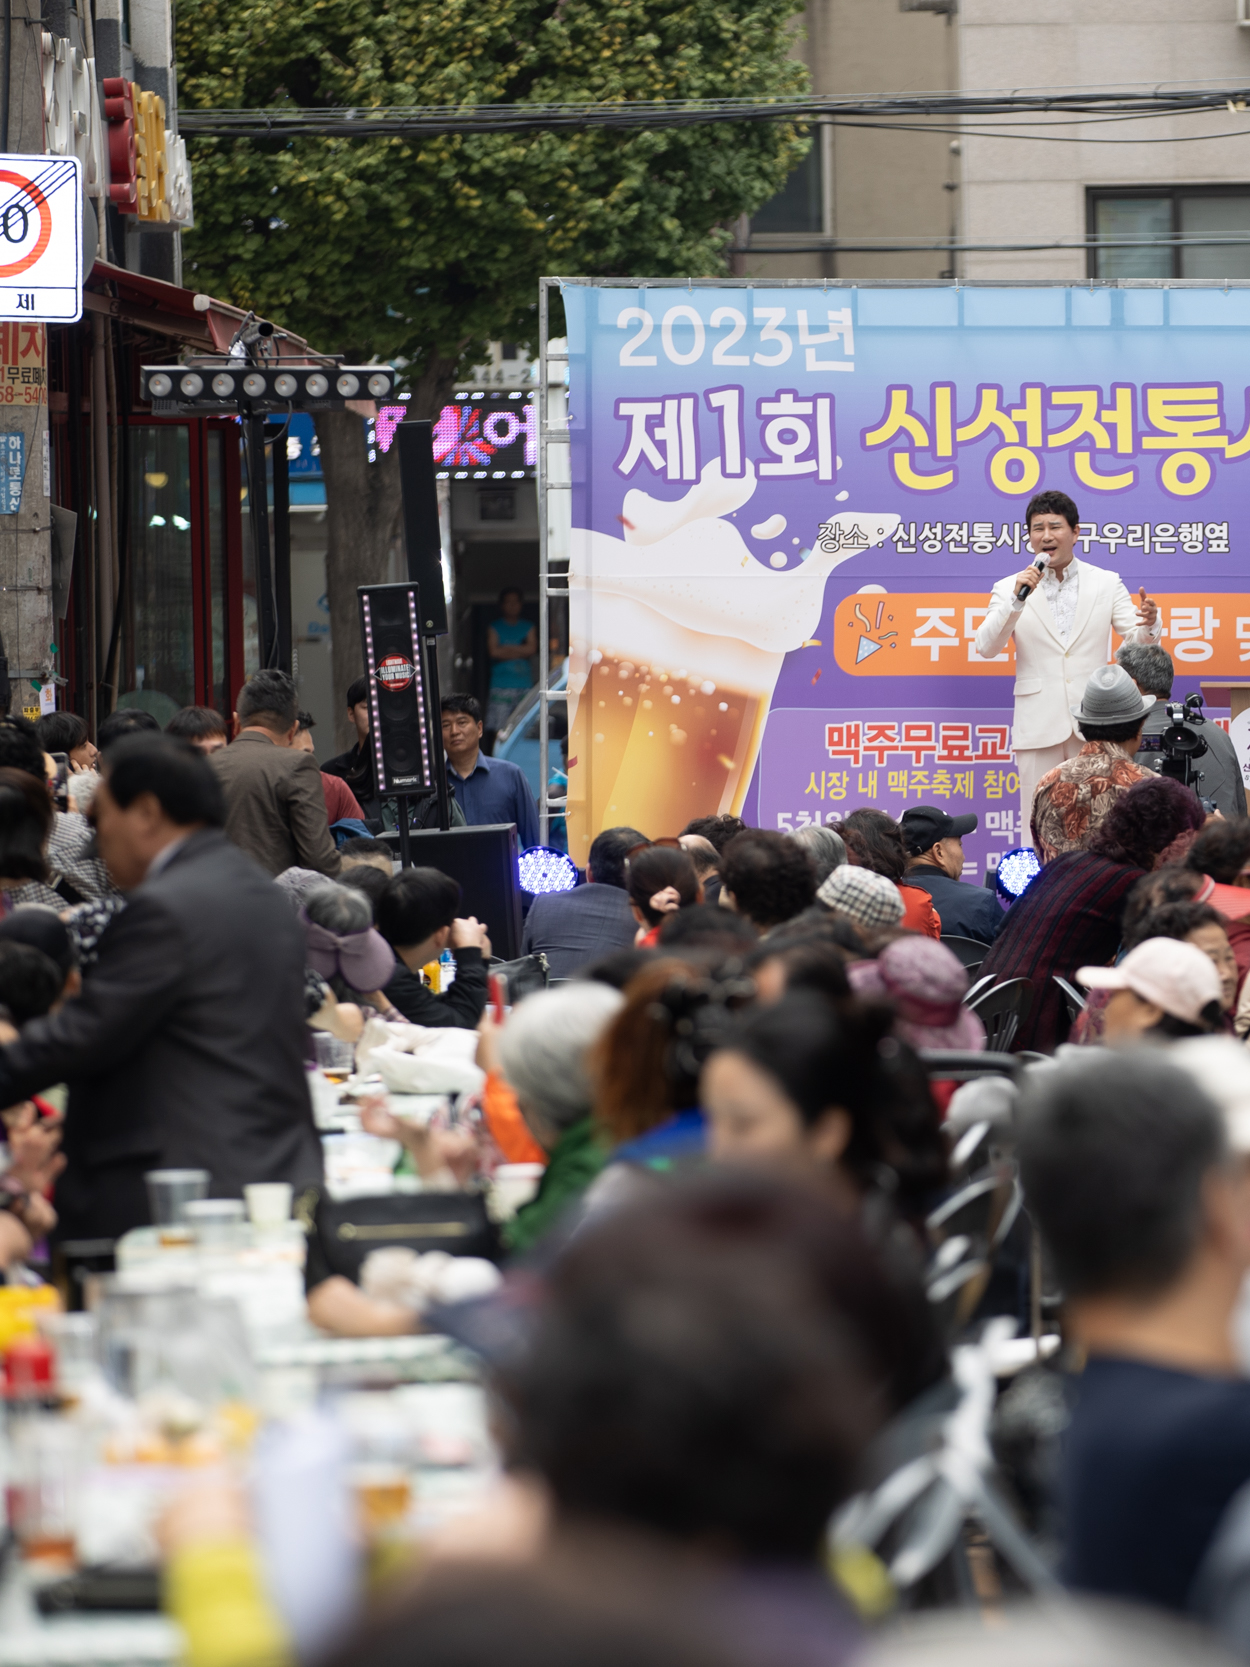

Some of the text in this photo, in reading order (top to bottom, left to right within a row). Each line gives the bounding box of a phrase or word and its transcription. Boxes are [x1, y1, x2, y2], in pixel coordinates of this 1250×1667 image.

[616, 305, 855, 372] 2023년
[616, 386, 835, 482] 제1회
[817, 522, 870, 553] 장소
[825, 721, 1017, 767] 맥주무료교
[805, 770, 849, 800] 시장
[858, 770, 877, 799] 내
[888, 769, 974, 799] 맥주축제
